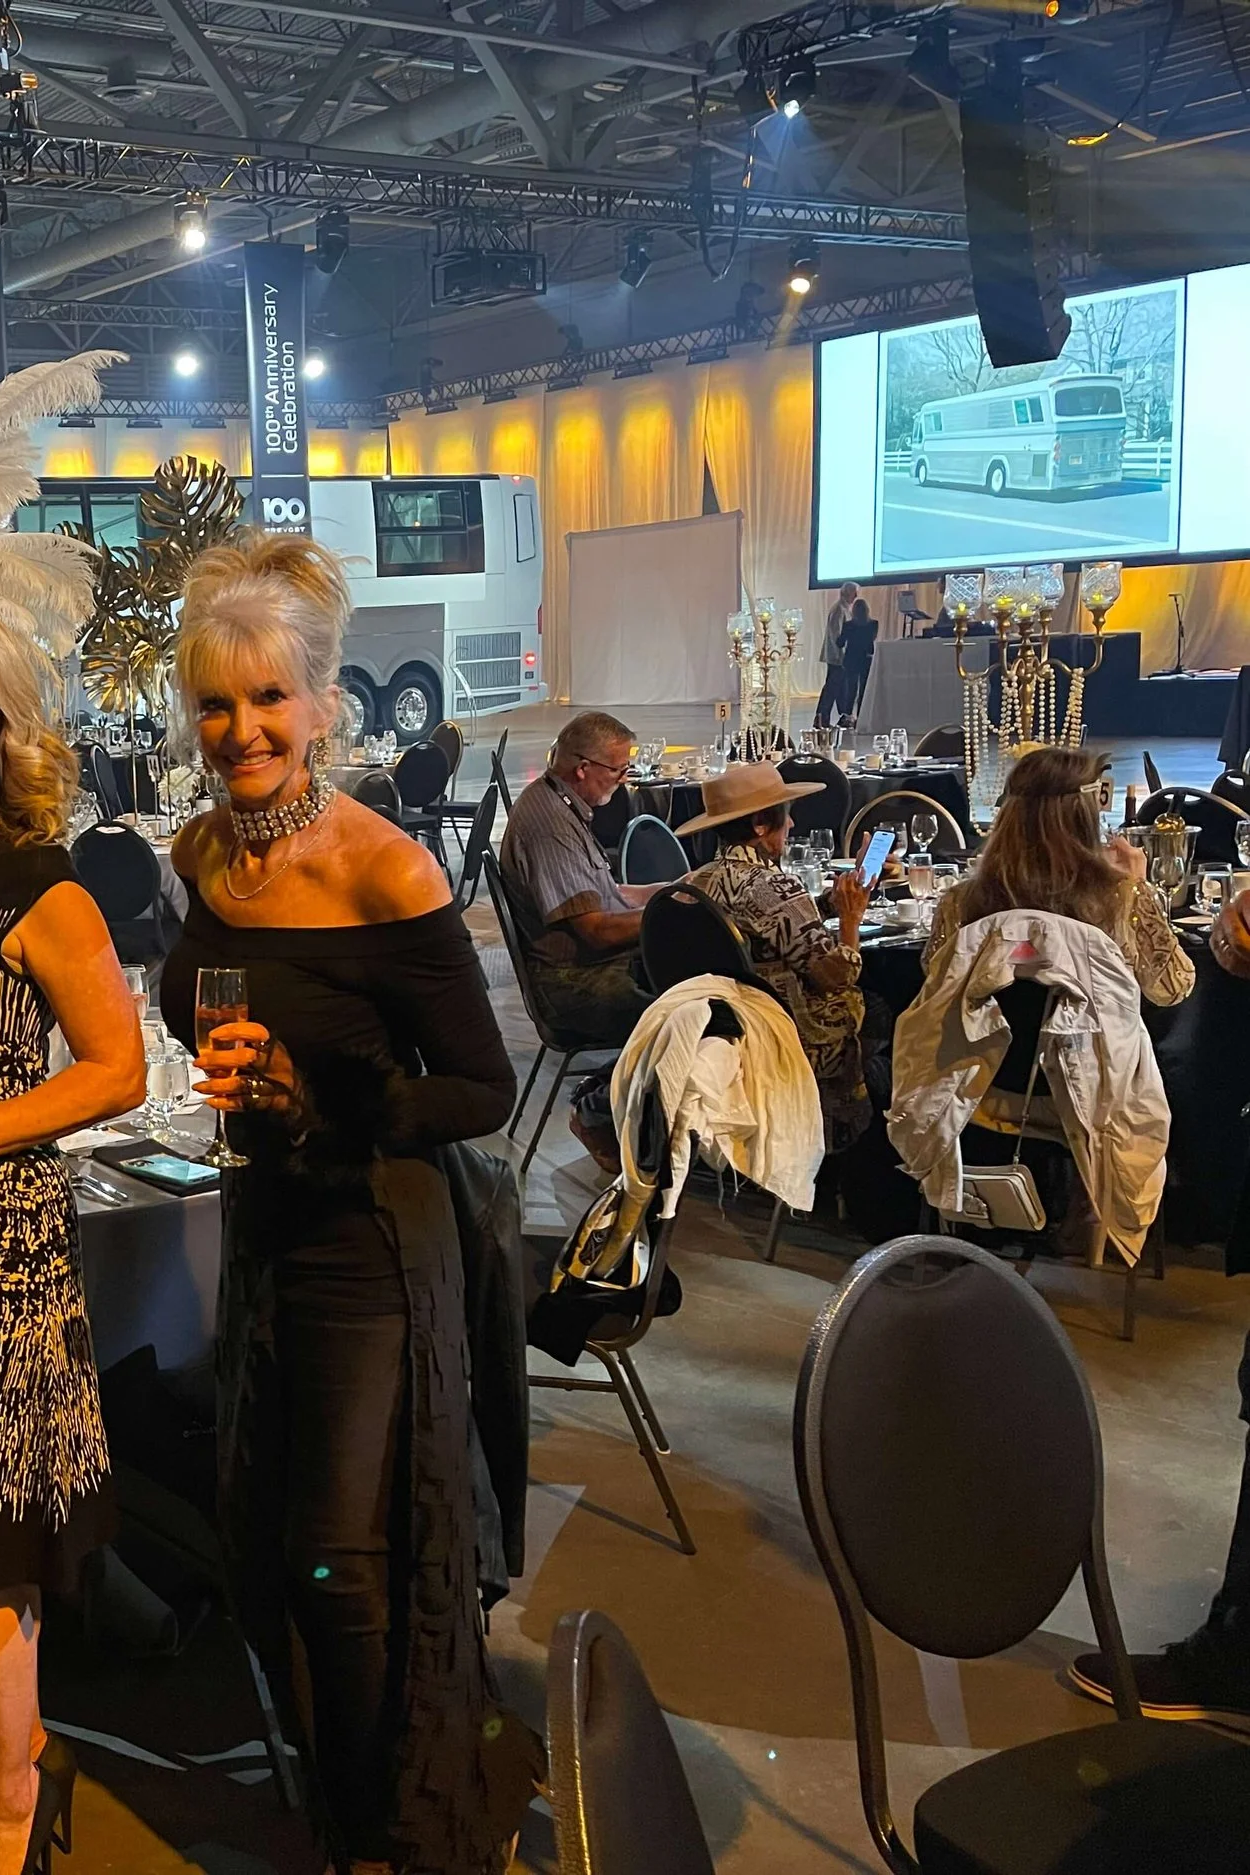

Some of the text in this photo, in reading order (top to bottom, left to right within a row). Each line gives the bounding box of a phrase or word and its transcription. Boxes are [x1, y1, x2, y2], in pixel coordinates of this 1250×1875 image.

[264, 282, 279, 405] Anniversary
[281, 341, 298, 454] Celebration
[261, 497, 306, 523] 100
[720, 704, 726, 718] 5
